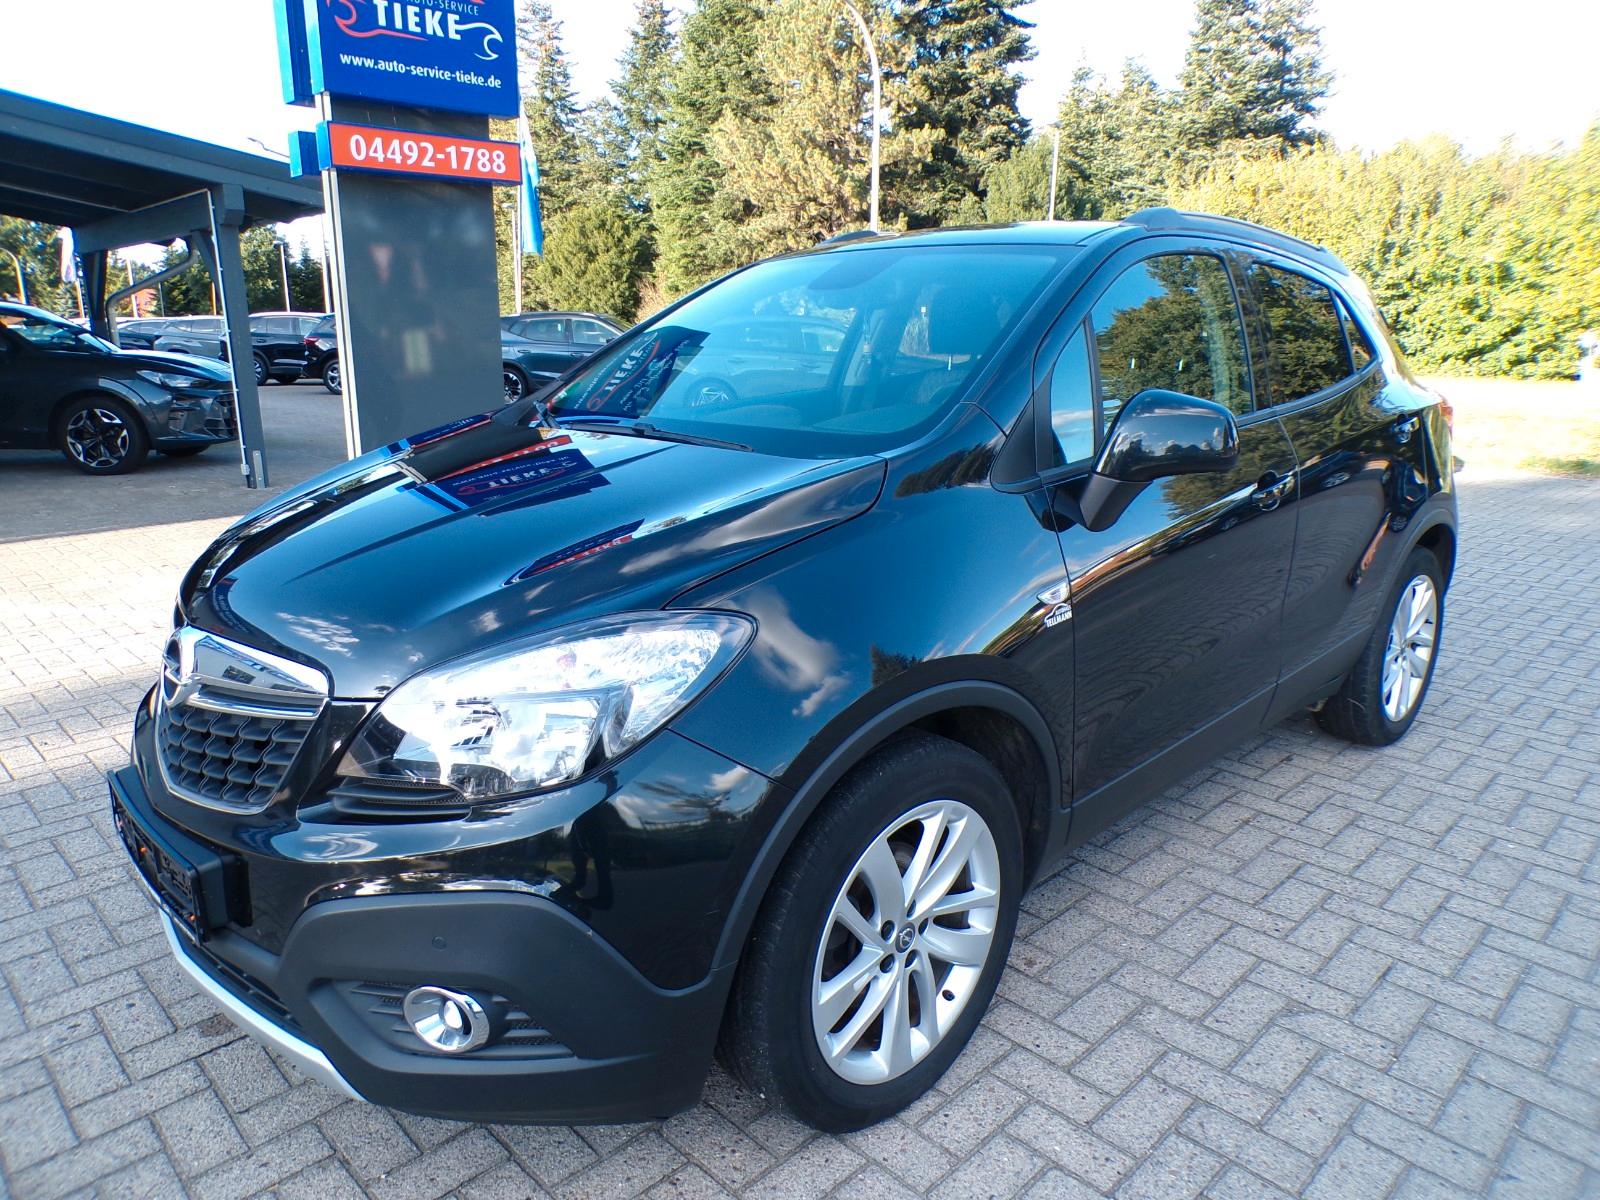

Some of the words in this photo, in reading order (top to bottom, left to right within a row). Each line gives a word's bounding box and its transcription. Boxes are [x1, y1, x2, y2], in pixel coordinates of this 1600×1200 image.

[373, 0, 462, 40] TIEKE
[339, 53, 502, 88] www.auto-service-tieke.de
[350, 134, 506, 174] 04492-1788
